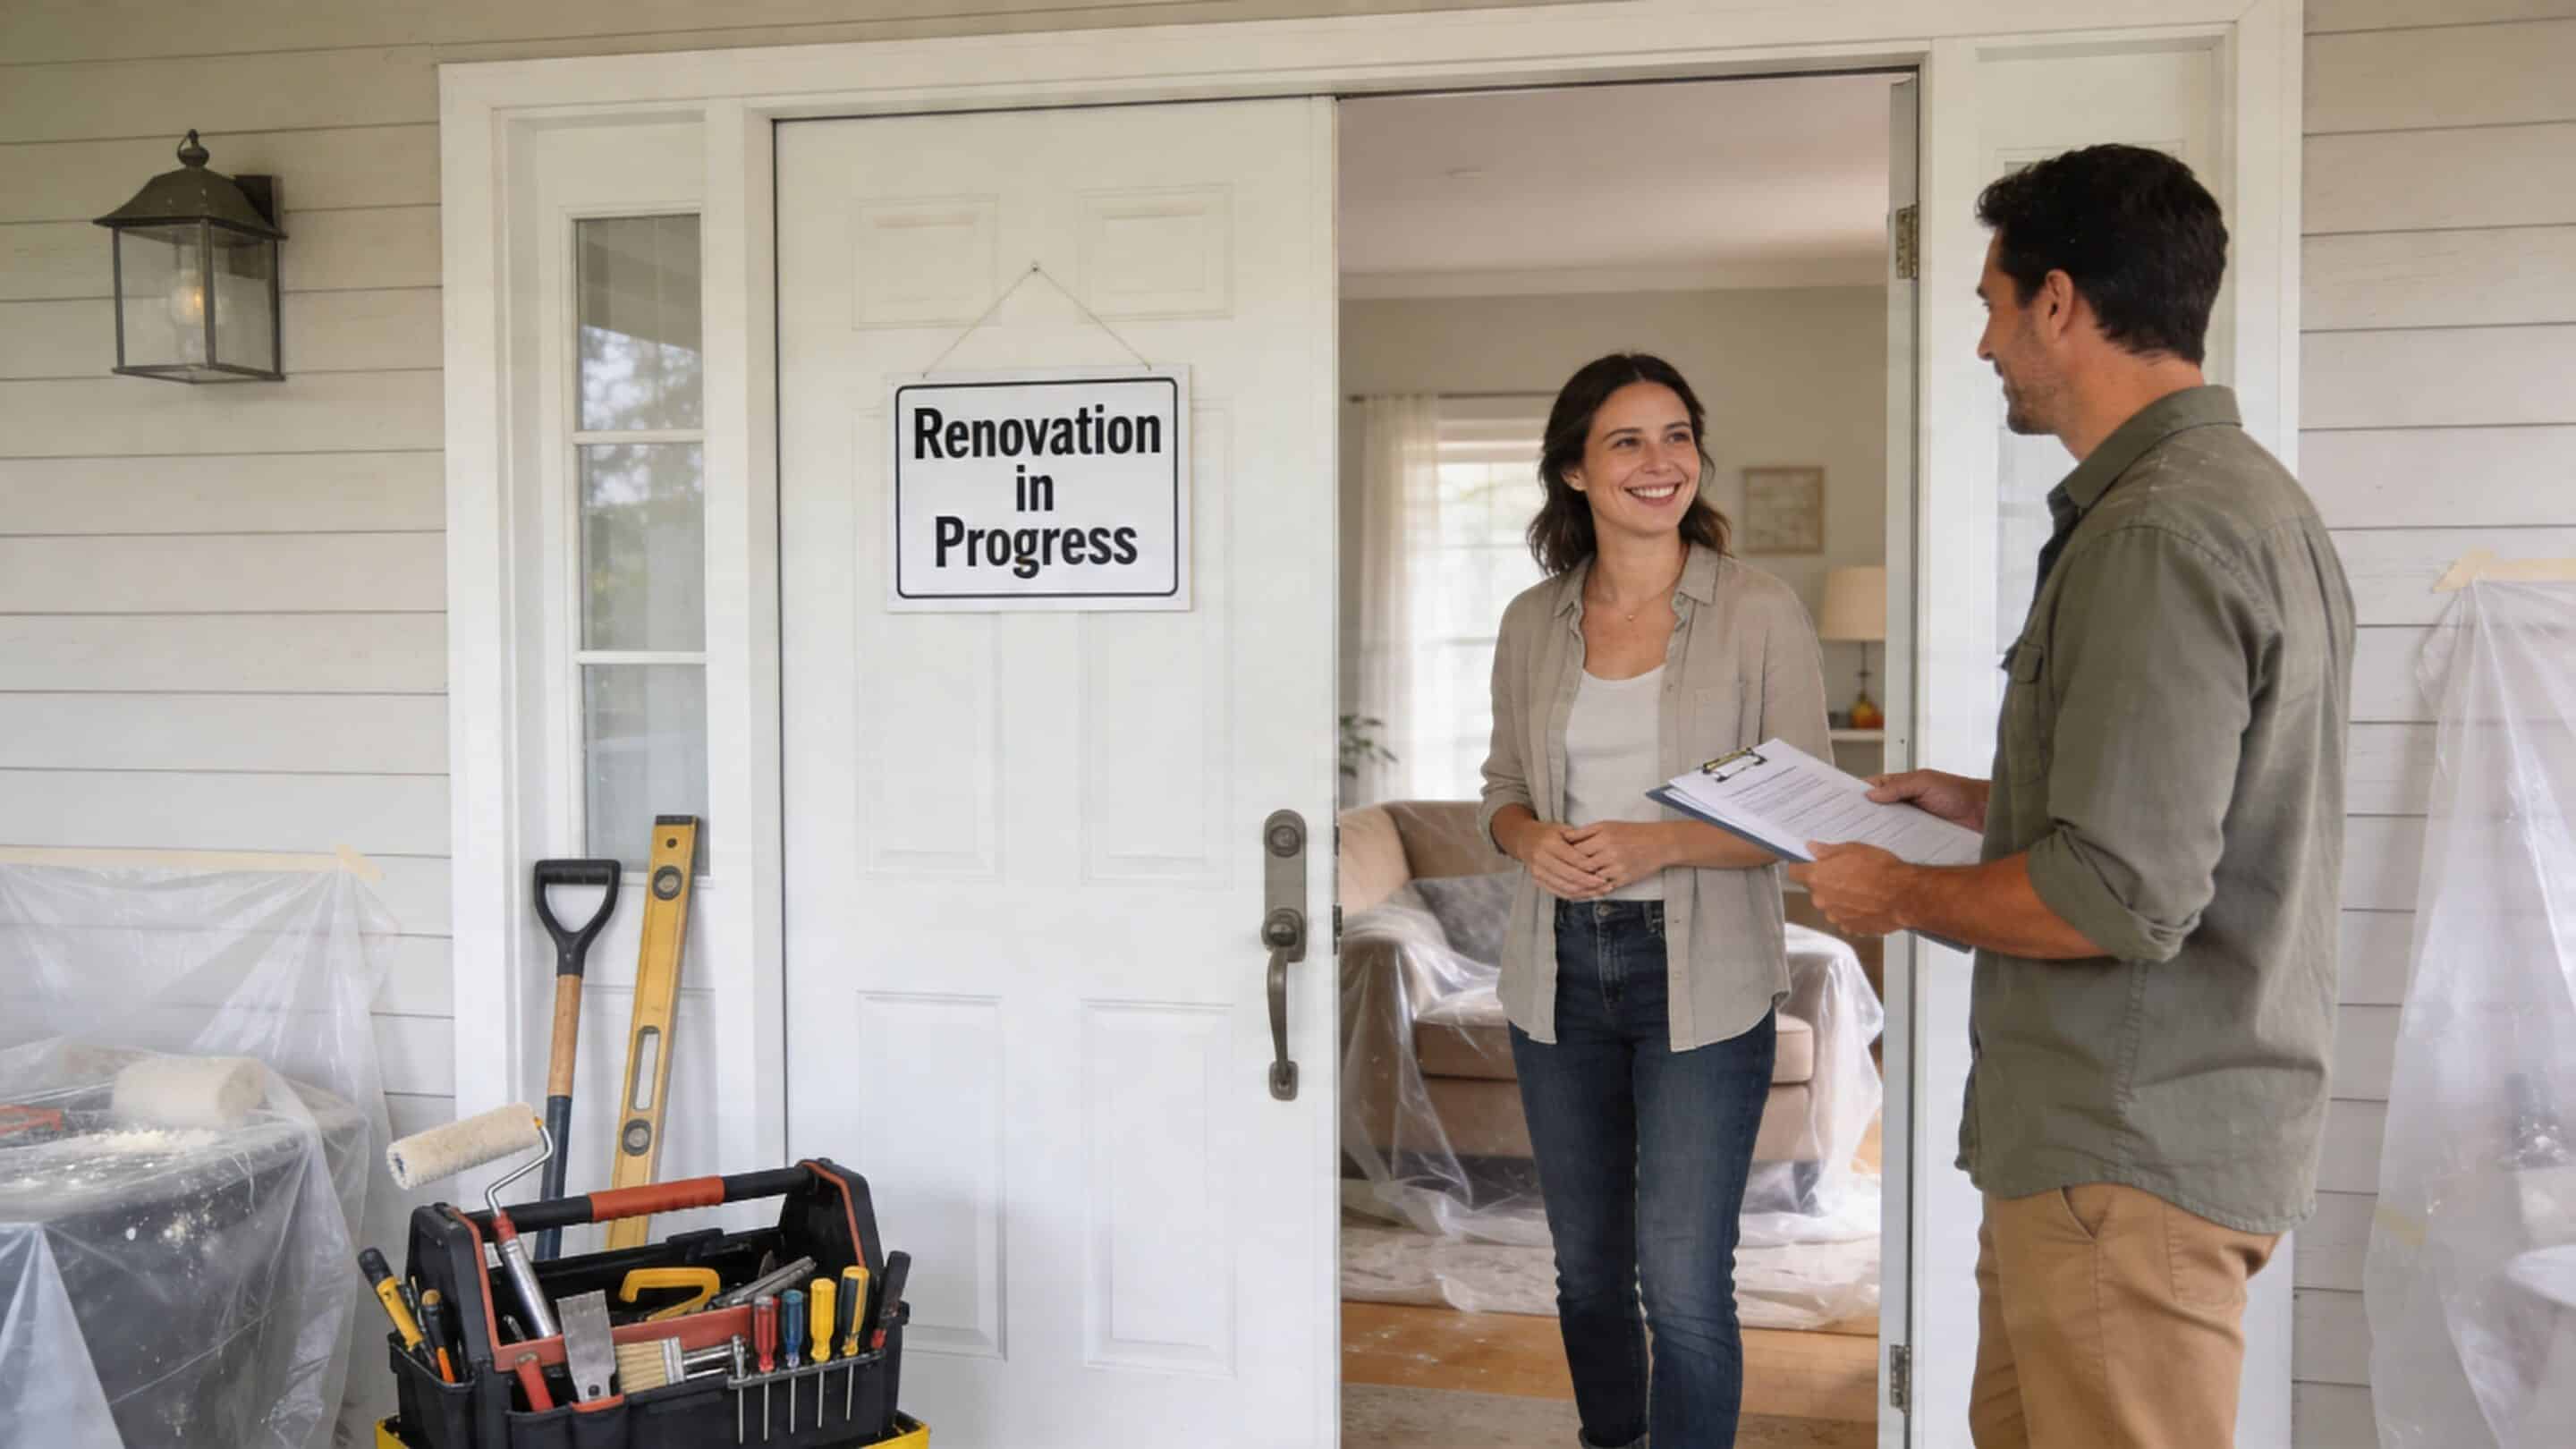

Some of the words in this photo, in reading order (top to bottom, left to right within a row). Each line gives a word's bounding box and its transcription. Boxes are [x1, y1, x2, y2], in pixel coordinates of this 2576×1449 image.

[915, 404, 1160, 459] Renovation
[1017, 465, 1053, 512] in
[936, 516, 1137, 579] Progress
